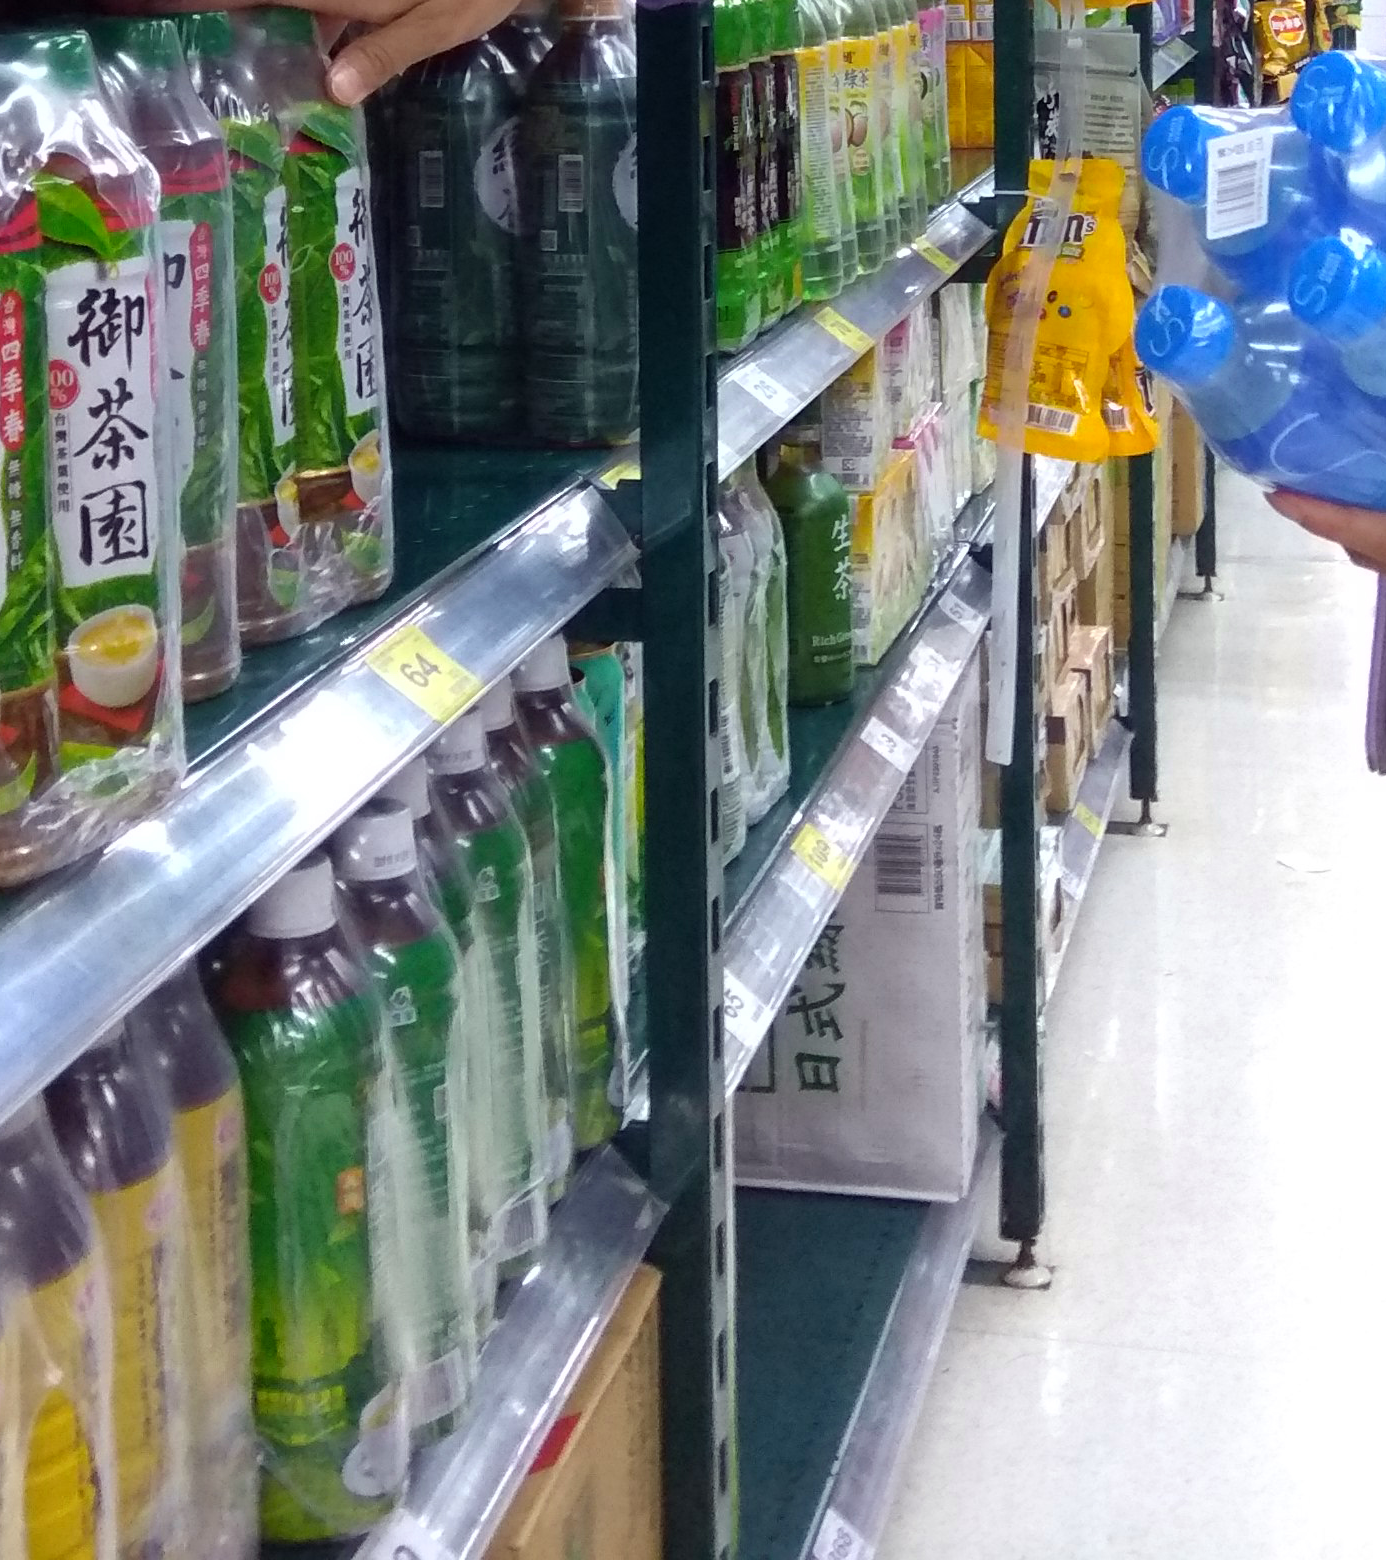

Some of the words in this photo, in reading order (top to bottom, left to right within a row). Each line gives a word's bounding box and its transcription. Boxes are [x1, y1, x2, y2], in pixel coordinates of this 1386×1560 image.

[334, 251, 354, 265] 100
[0, 295, 25, 444] 台灣四季春
[49, 369, 75, 388] 00
[68, 288, 149, 567] 御茶園
[399, 652, 442, 688] 64
